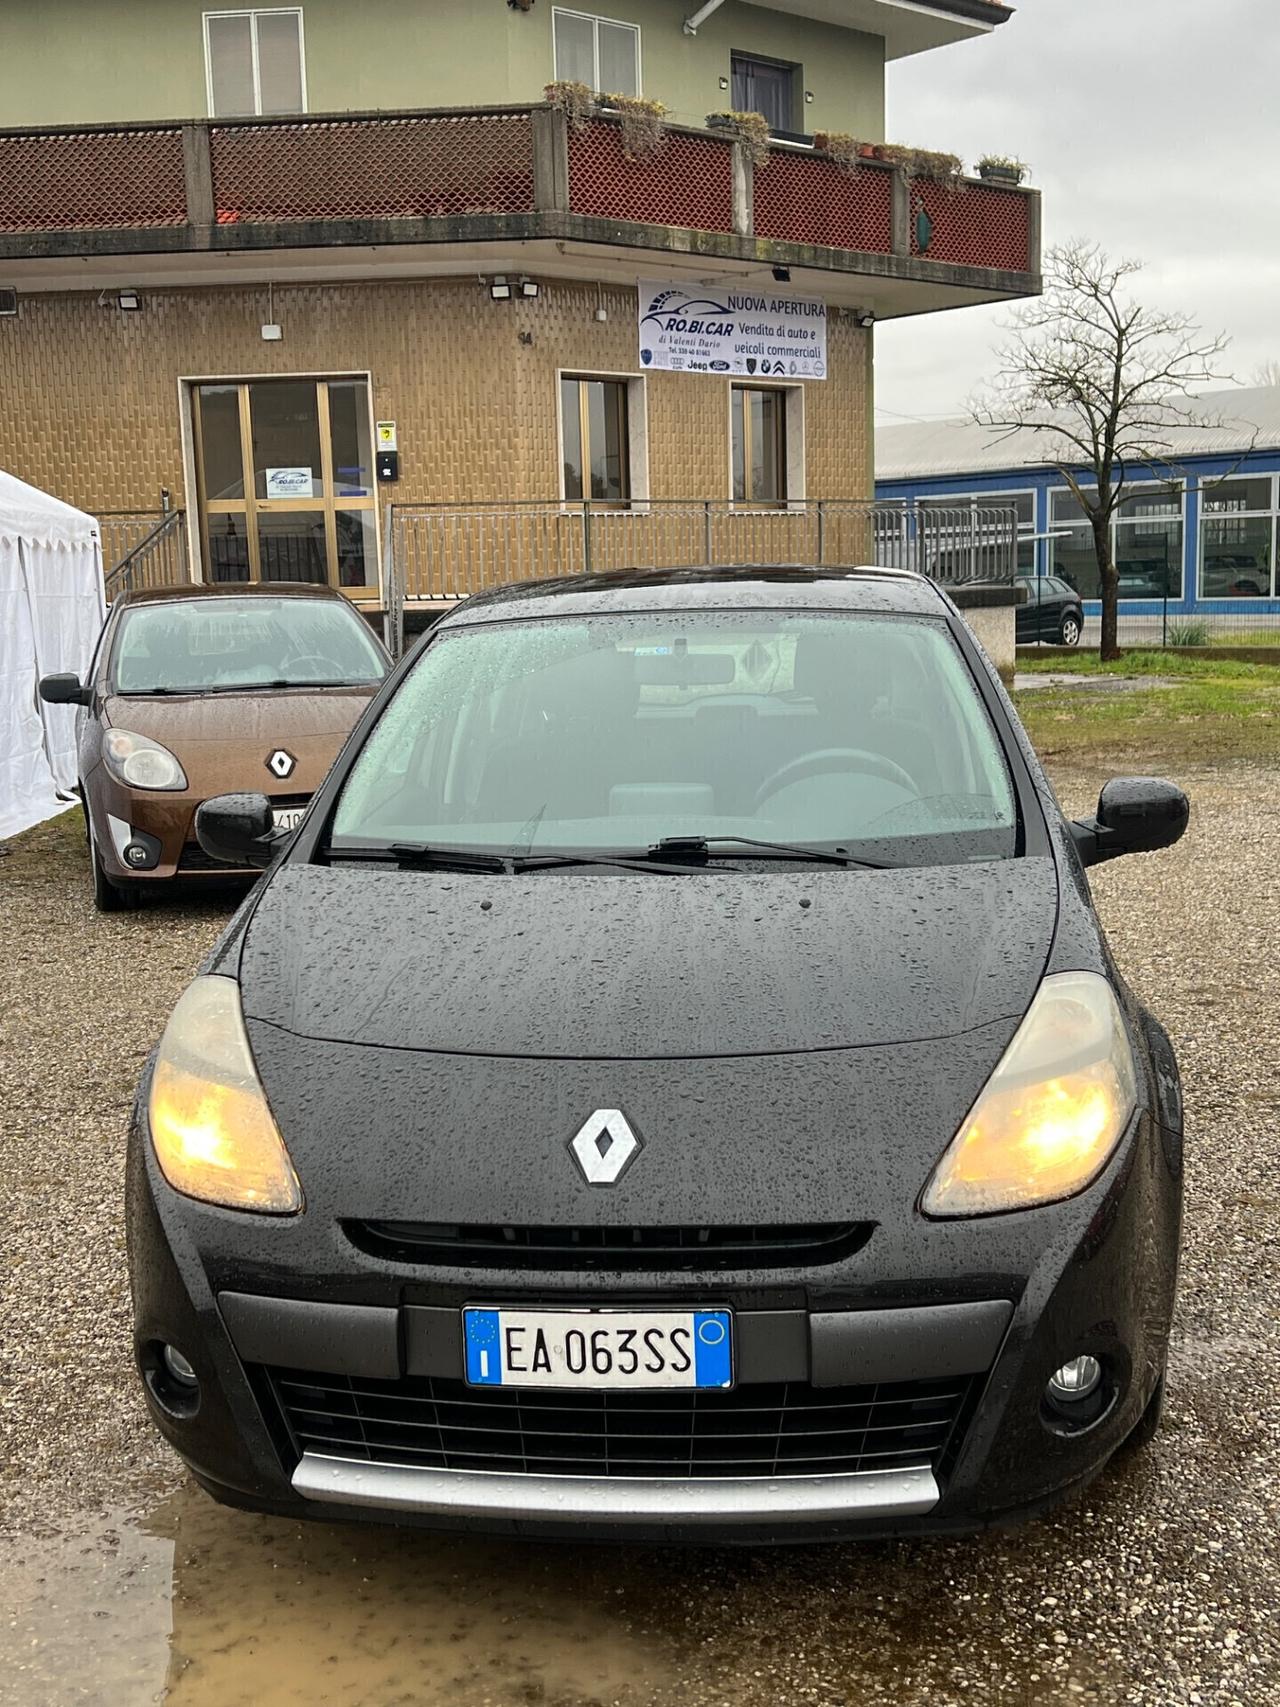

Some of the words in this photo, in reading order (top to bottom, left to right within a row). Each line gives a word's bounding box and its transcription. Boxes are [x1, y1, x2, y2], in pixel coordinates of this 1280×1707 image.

[728, 296, 767, 312] NUOVA
[770, 300, 825, 317] APERTURA
[665, 318, 734, 336] RO.BI.CAR
[739, 322, 774, 336] Vendita
[776, 326, 785, 337] di
[787, 328, 808, 339] auto
[810, 330, 816, 340] e
[658, 334, 666, 344] di
[669, 336, 696, 346] Valenti
[698, 338, 721, 348] Dario
[734, 341, 764, 355] veicoli
[767, 345, 820, 359] commerciali
[687, 360, 708, 371] Jeep
[480, 1350, 489, 1377] I
